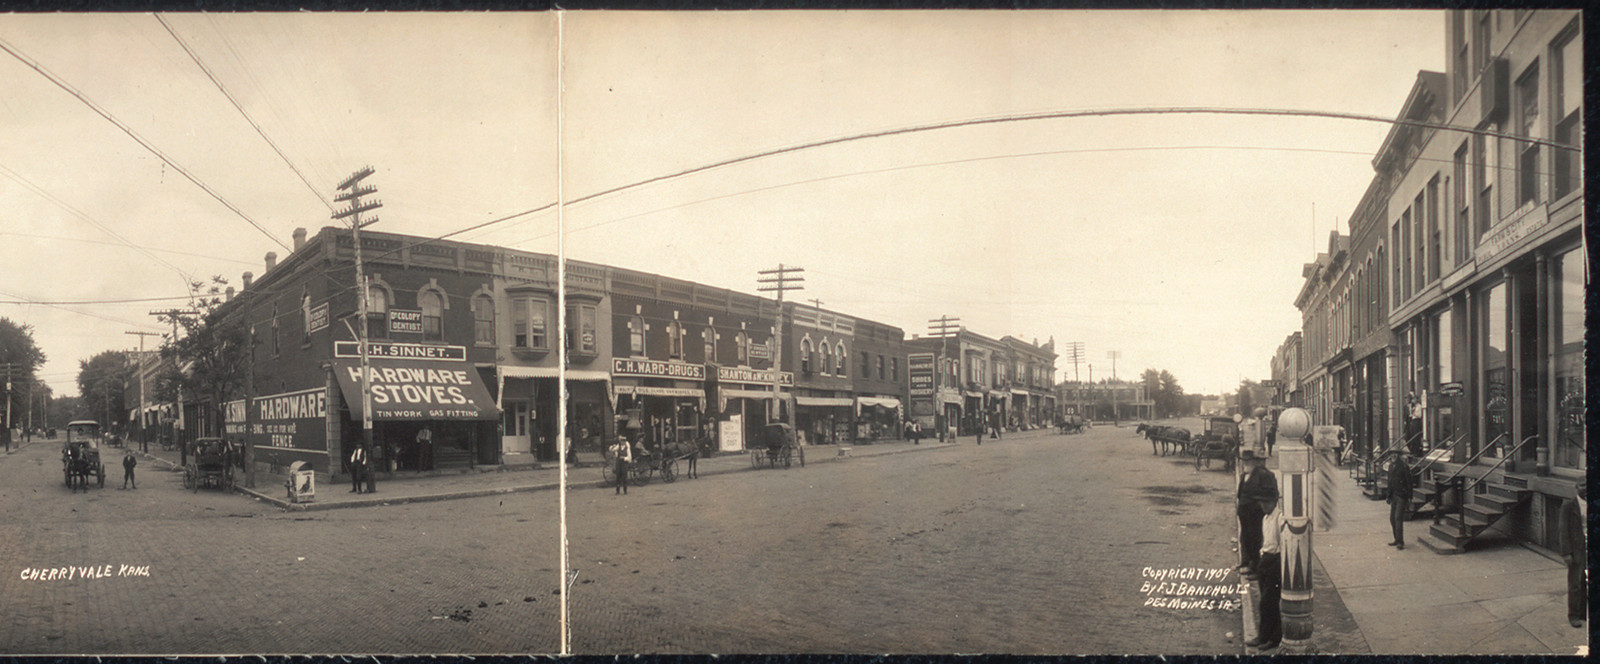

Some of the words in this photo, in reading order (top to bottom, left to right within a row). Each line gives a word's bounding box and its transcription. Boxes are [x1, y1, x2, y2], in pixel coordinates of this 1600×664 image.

[399, 312, 421, 321] COLOPY
[347, 366, 472, 385] HARDWARE
[370, 385, 475, 405] STOVES.
[260, 392, 326, 420] HARDWARE
[376, 410, 391, 418] TIN
[393, 410, 423, 418] WORK
[429, 410, 443, 418] GAS
[446, 410, 479, 418] FITTING
